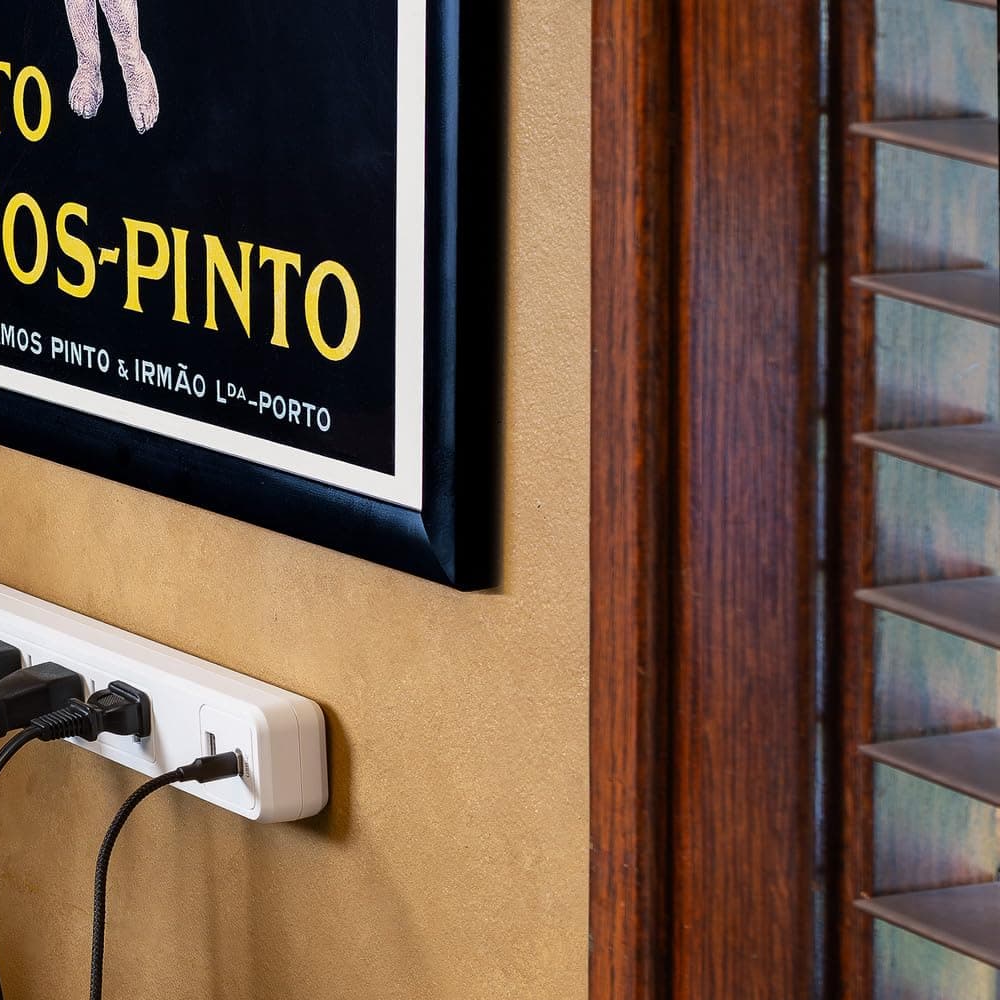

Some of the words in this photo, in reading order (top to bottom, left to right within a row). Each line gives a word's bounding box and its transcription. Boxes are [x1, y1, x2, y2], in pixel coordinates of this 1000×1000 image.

[51, 335, 110, 373] PINTO
[118, 358, 129, 380] &
[135, 357, 207, 398] IRMÃO
